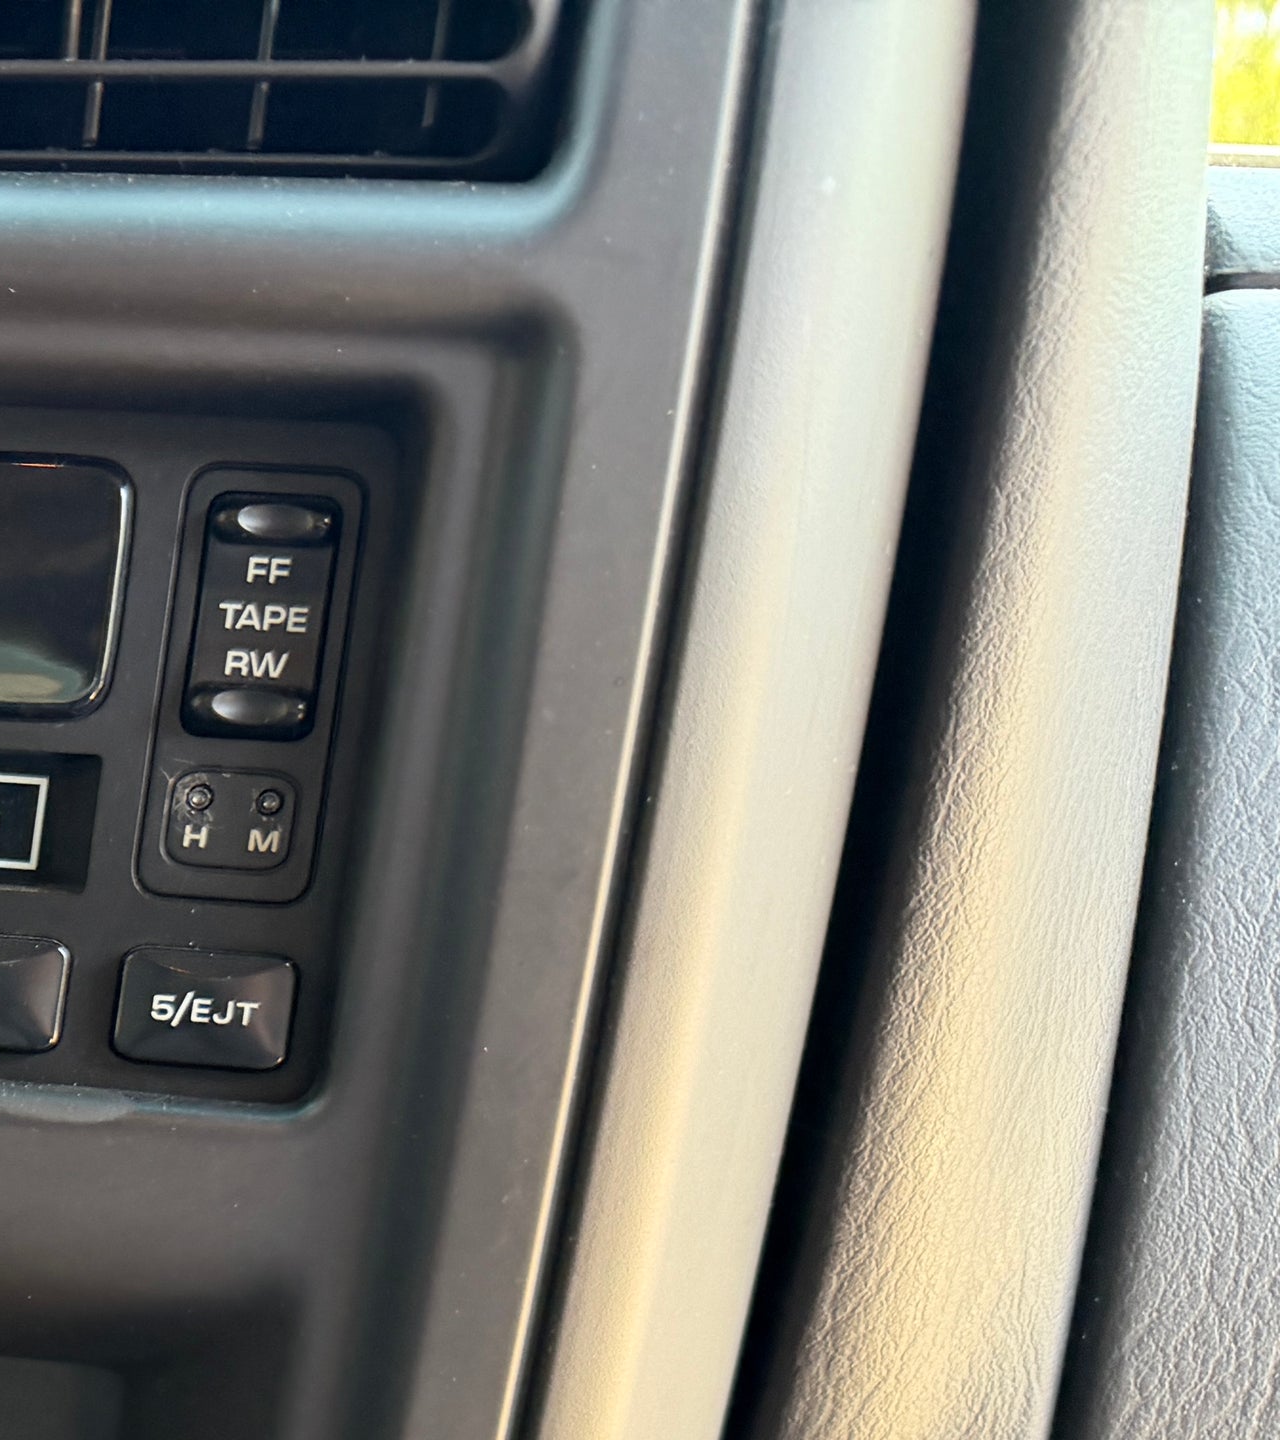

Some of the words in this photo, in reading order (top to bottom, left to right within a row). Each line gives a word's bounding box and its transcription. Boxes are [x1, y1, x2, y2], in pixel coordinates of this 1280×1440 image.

[246, 556, 292, 585] FF
[219, 601, 309, 633] TAPE
[224, 650, 289, 679] RW
[182, 826, 209, 849] H
[247, 828, 281, 854] M
[150, 990, 261, 1028] 5/EJT
